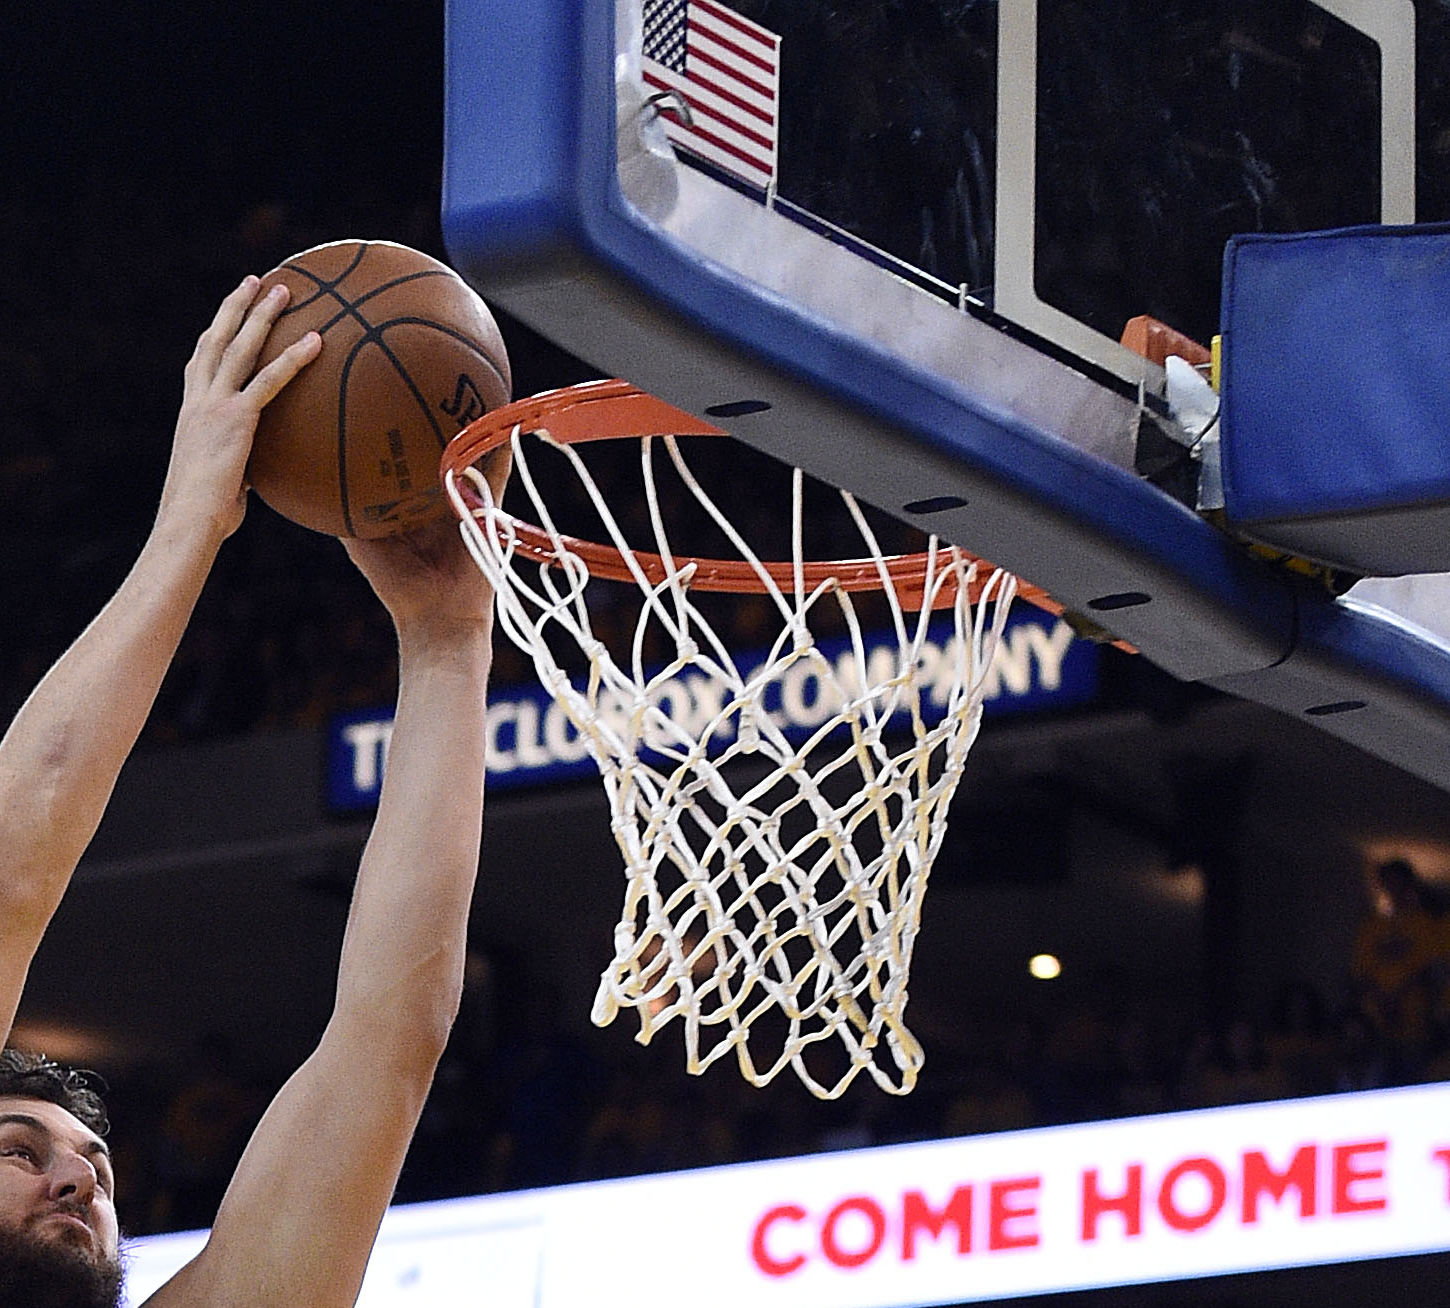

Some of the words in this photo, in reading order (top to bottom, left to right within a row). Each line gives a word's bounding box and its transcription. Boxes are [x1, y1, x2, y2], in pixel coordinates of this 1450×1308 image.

[746, 616, 1076, 730] COMPANY
[751, 1176, 1041, 1277] COME
[1081, 1140, 1387, 1240] HOME
